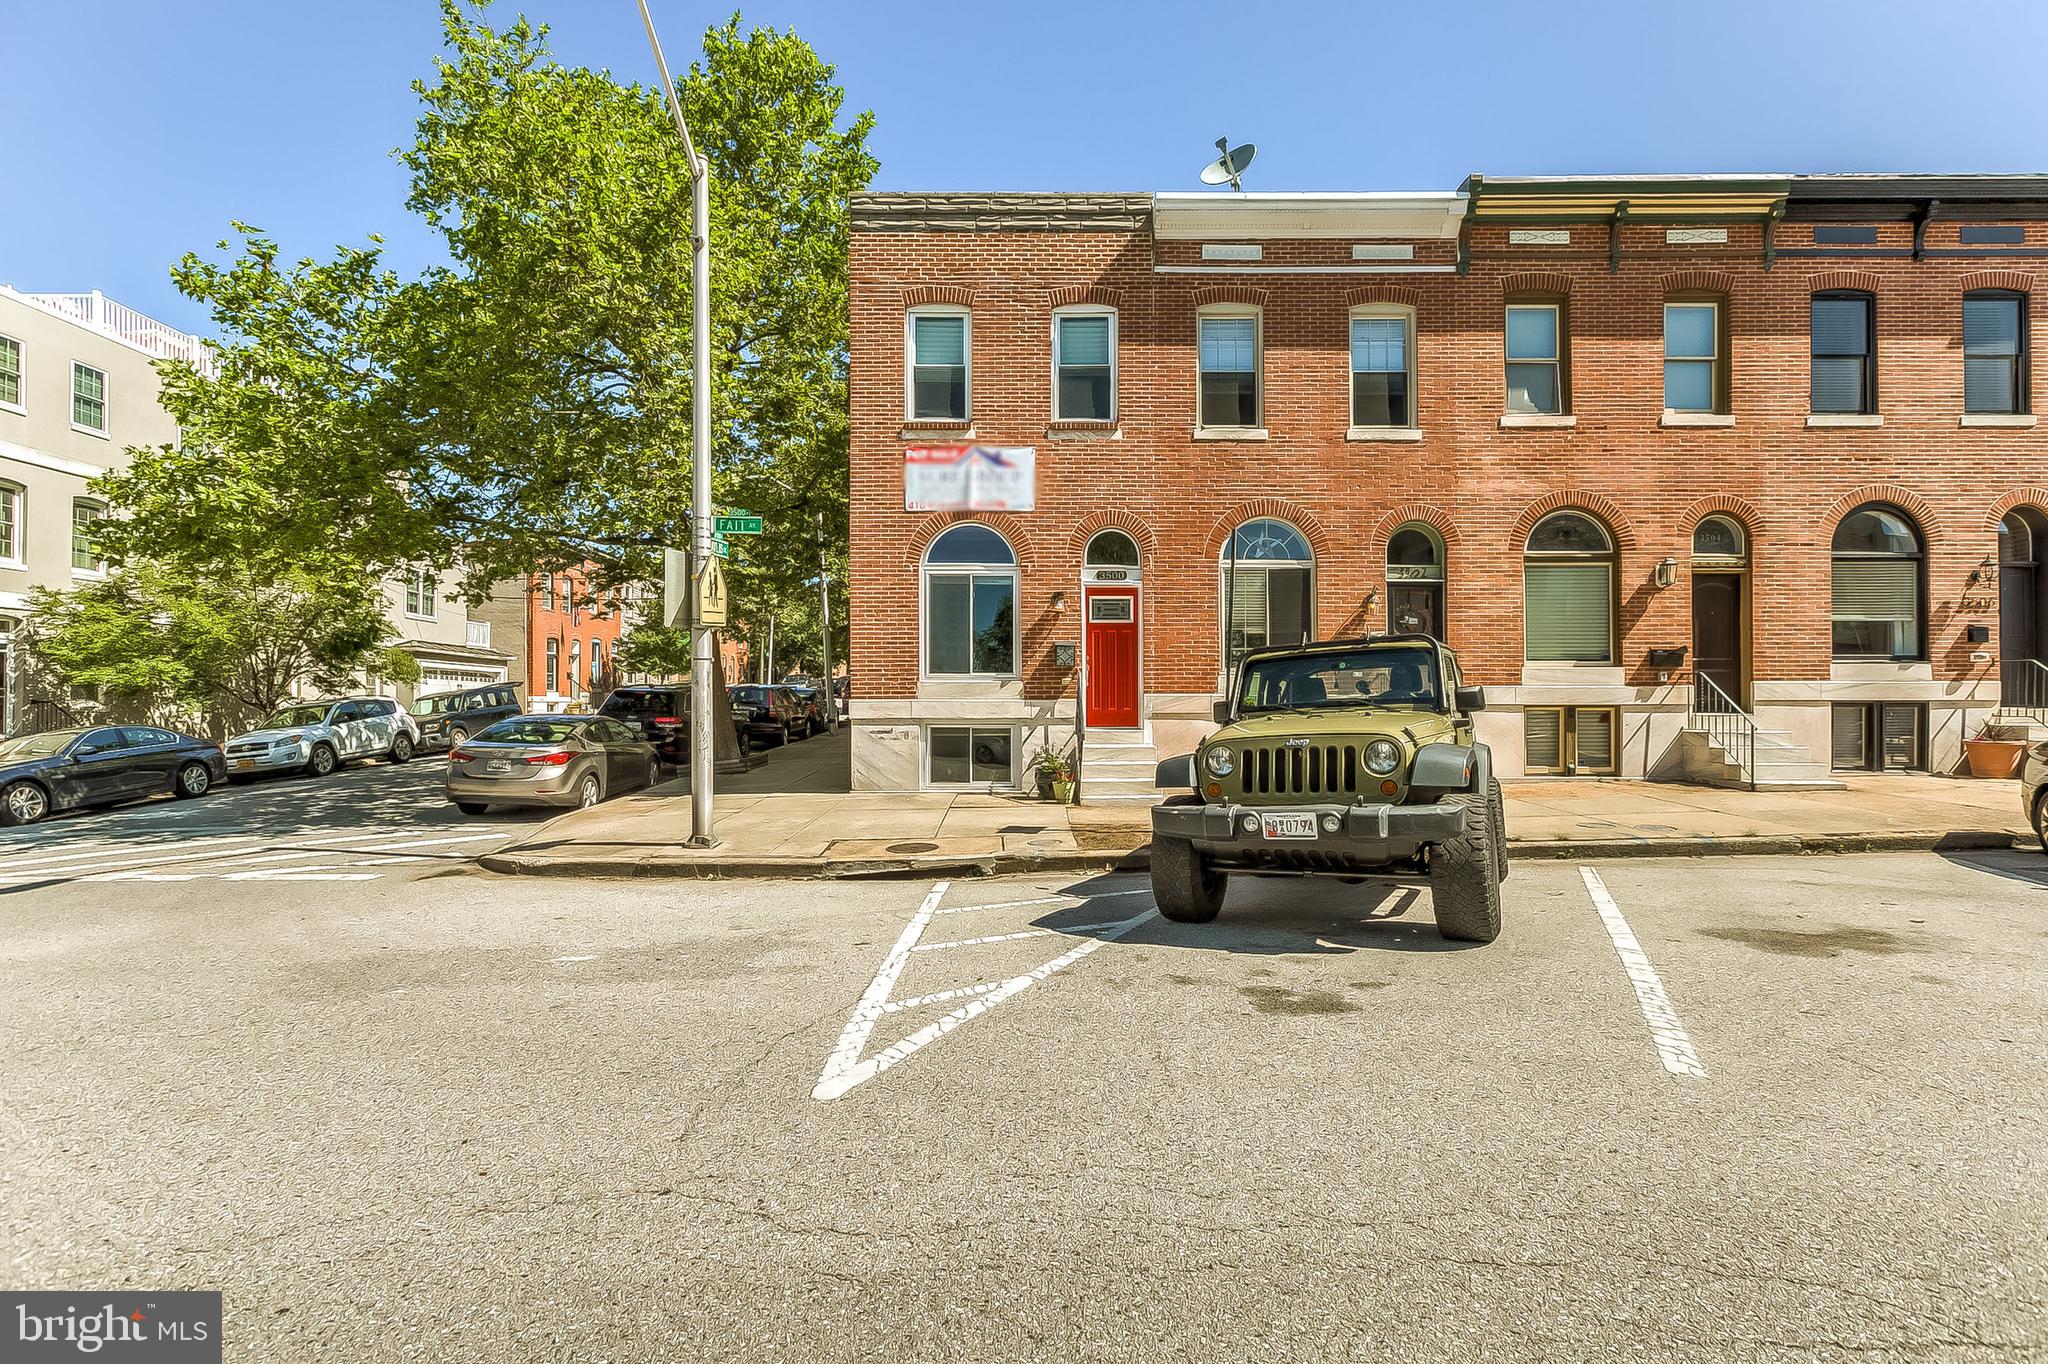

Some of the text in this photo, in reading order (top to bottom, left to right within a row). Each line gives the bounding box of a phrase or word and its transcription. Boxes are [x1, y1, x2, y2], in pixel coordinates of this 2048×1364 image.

[719, 519, 744, 531] FAIT
[1700, 534, 1721, 542] 3504
[1099, 571, 1125, 580] 3500
[1286, 738, 1310, 747] Jeep
